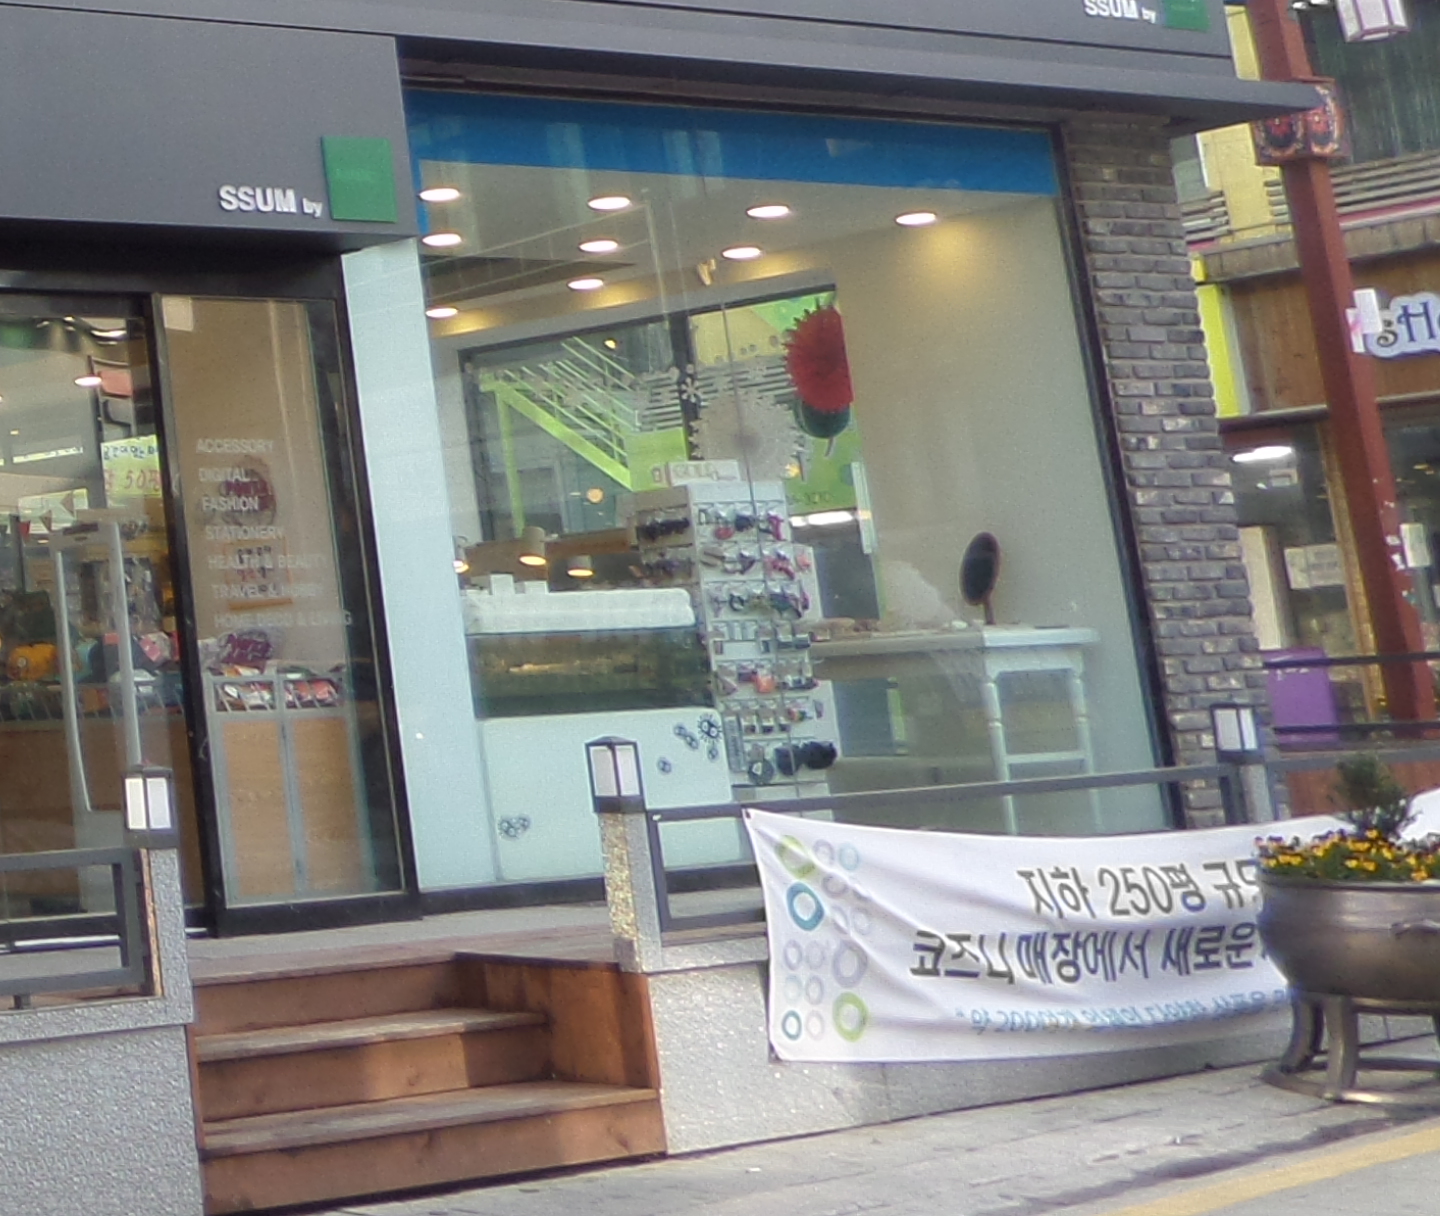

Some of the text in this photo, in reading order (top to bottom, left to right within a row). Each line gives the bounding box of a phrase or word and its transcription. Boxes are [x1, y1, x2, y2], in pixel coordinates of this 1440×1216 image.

[1142, 7, 1156, 24] by
[219, 185, 323, 218] SSUM by
[196, 439, 275, 453] ACCESSORY
[199, 468, 252, 482] DIGITAL
[202, 496, 259, 511] FASHION
[1017, 867, 1096, 920] 지하
[1097, 863, 1206, 916] 250평
[1159, 922, 1256, 976] 새로운
